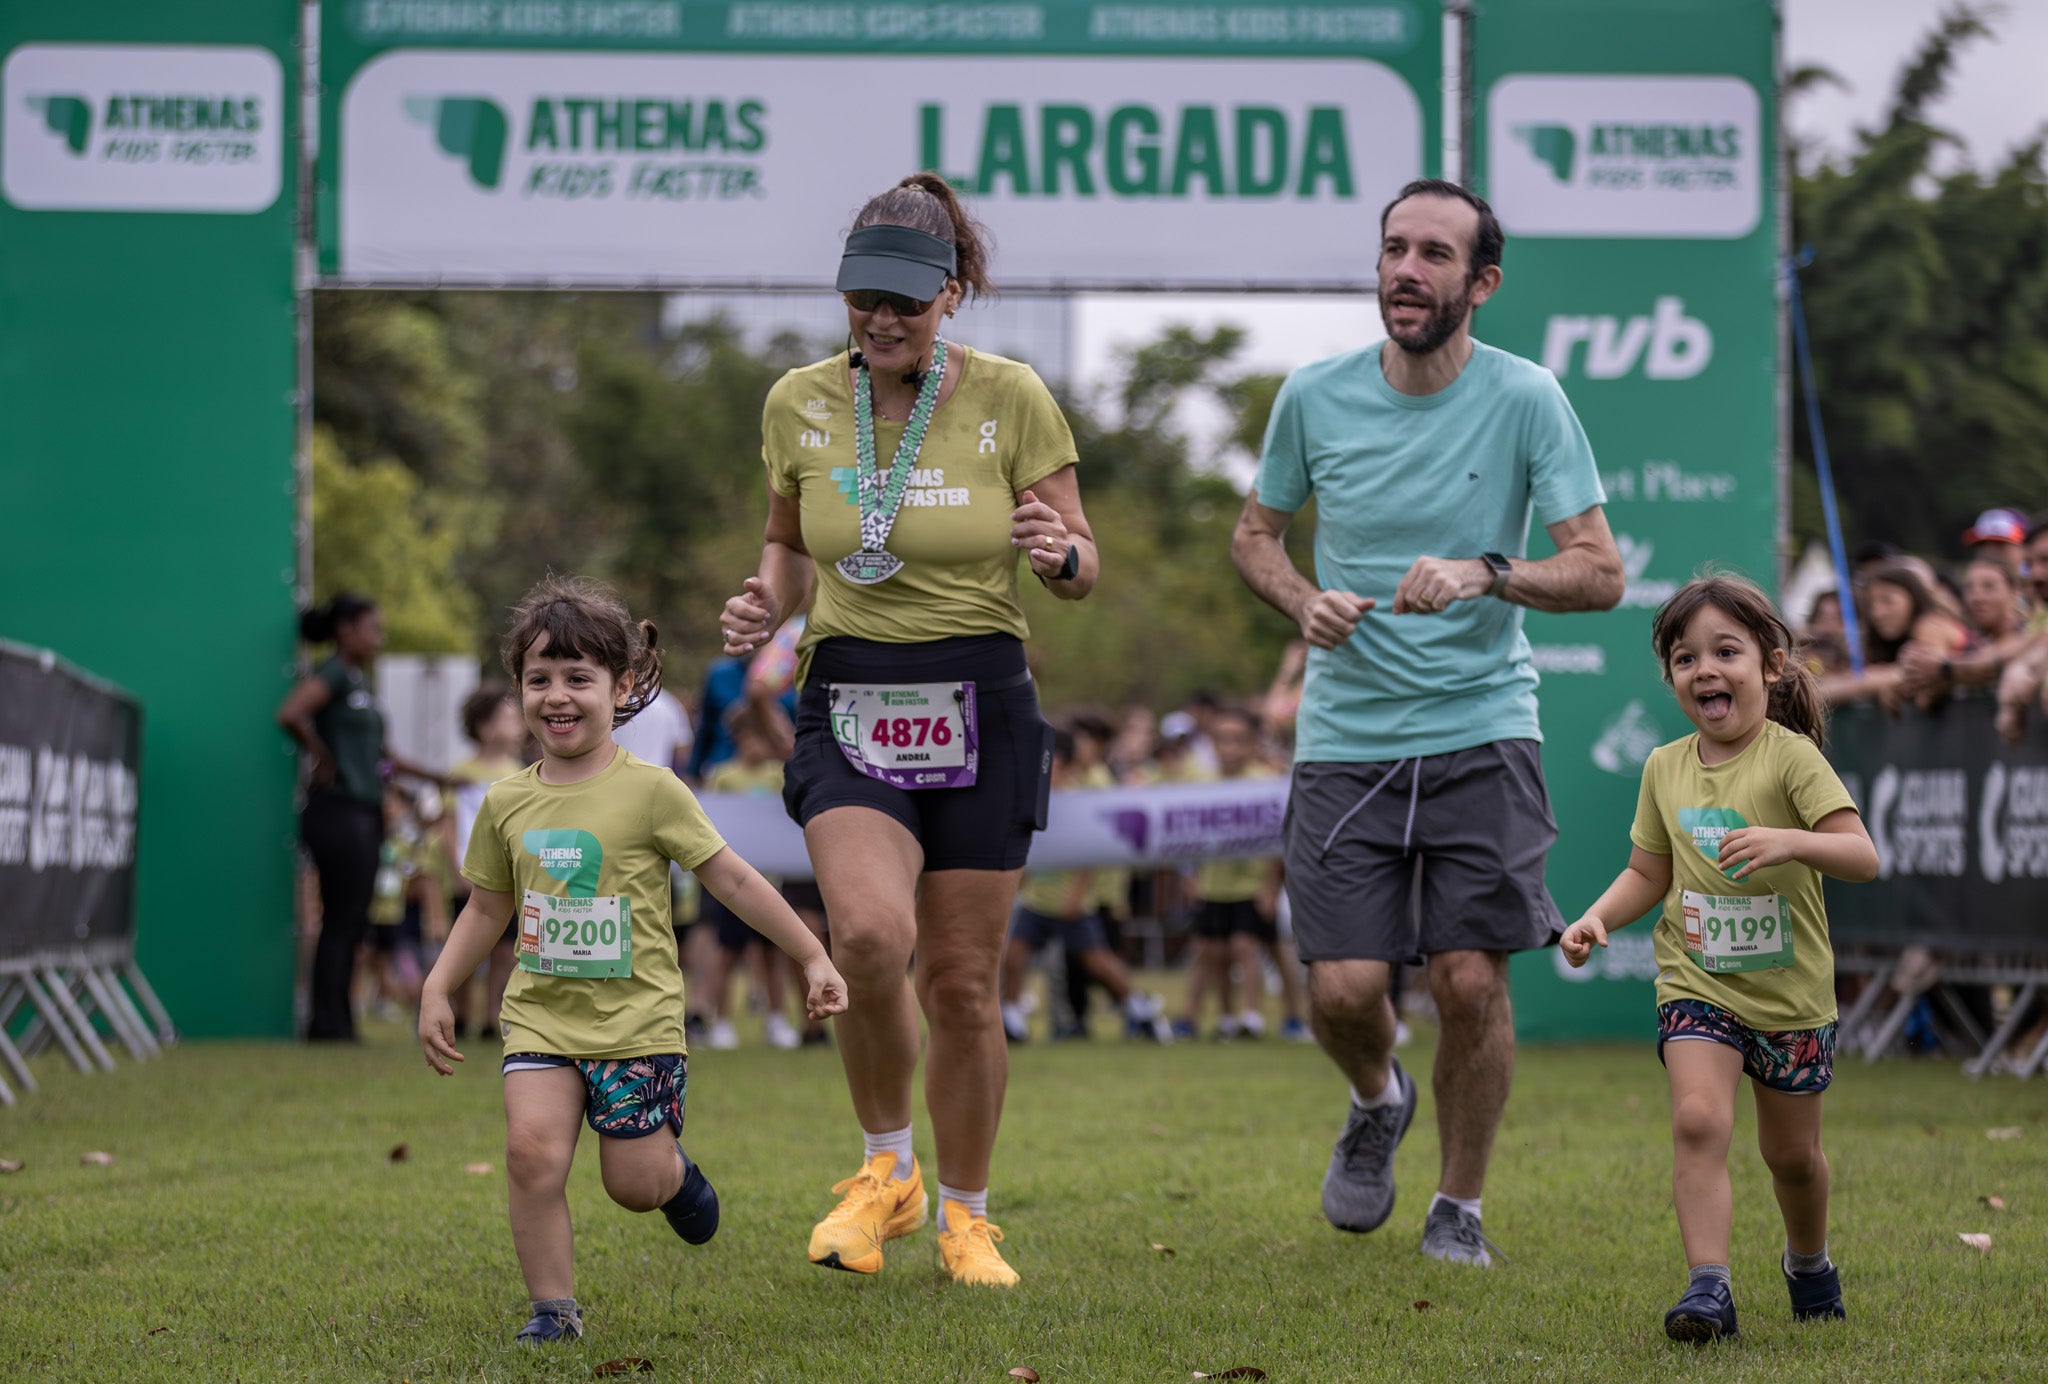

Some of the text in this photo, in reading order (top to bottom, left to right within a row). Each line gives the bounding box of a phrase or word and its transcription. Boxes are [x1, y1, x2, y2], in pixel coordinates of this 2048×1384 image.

[105, 94, 261, 133] ATHENAS
[526, 97, 767, 152] ATHENAS
[918, 102, 1357, 197] LARGADA
[1588, 123, 1741, 159] ATHENAS
[104, 138, 258, 166] KIDS FASTER
[522, 162, 767, 200] KIDS FASTER
[1541, 295, 1714, 381] rvb
[882, 447, 916, 508] ATHENAS
[904, 416, 926, 449] RUN
[915, 371, 939, 425] FASTER
[878, 468, 945, 487] TNAS
[903, 488, 971, 506] FASTER
[891, 690, 919, 698] ATHENAS
[905, 698, 929, 706] FASTER
[871, 717, 952, 747] 4876
[896, 753, 930, 762] ANDREA
[1692, 826, 1730, 838] ATHENAS
[539, 847, 582, 860] ATHENAS
[558, 898, 593, 907] ATHENAS
[1717, 896, 1752, 905] ATHENAS
[524, 907, 540, 917] 100m
[545, 918, 617, 946] 9200
[1707, 915, 1776, 942] 9199
[521, 942, 539, 953] 2020
[1687, 941, 1702, 952] 2020
[1731, 944, 1758, 952] MANUELA
